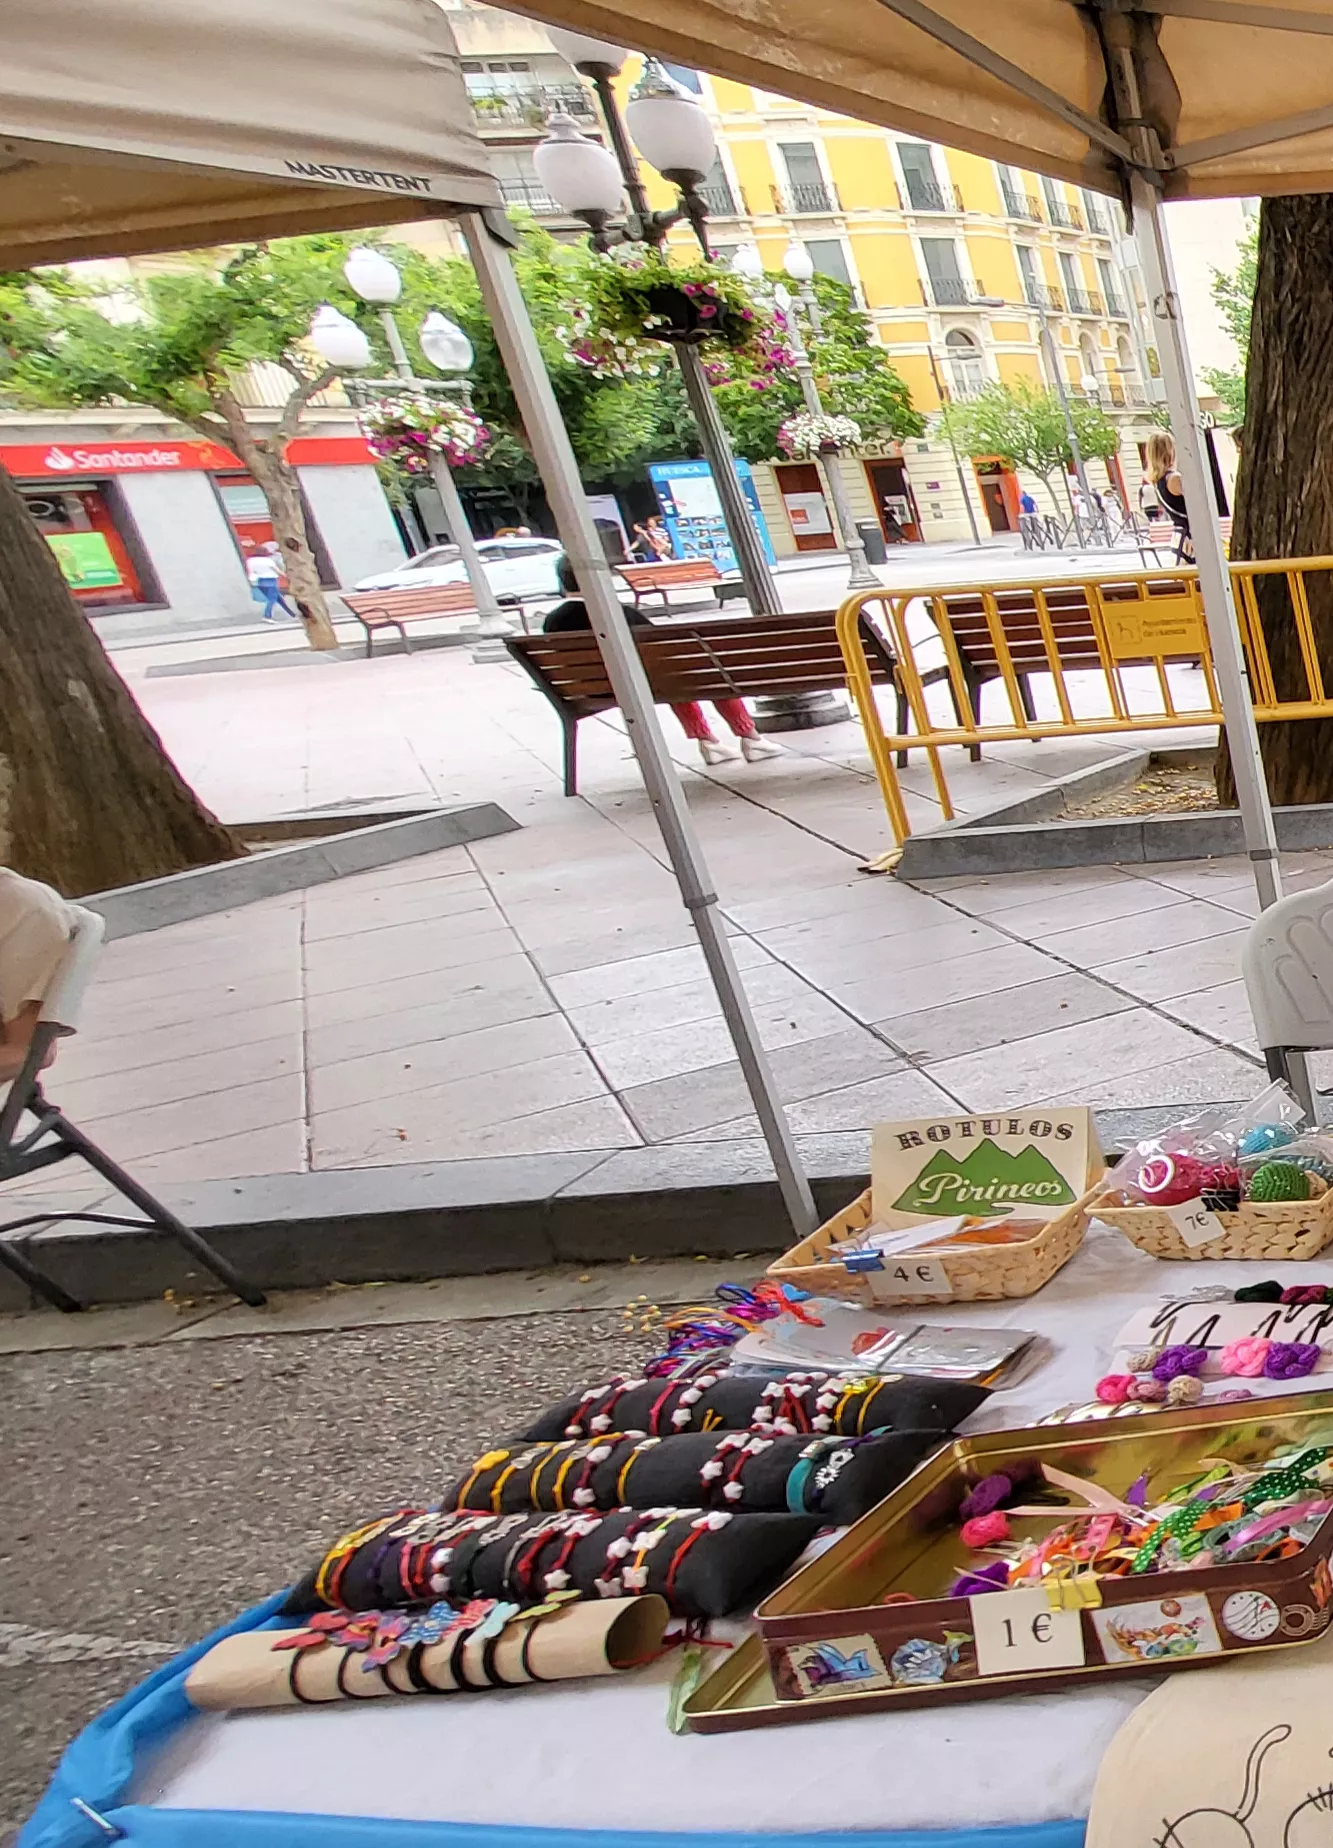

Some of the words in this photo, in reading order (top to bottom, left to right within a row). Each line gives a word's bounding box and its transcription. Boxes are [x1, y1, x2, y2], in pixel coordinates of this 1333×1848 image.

[284, 159, 432, 192] MASTERTENT
[73, 449, 181, 469] Santander
[893, 1118, 1075, 1151] ROTULOS
[912, 1172, 1063, 1207] Pirineos
[1184, 1211, 1210, 1230] 7€
